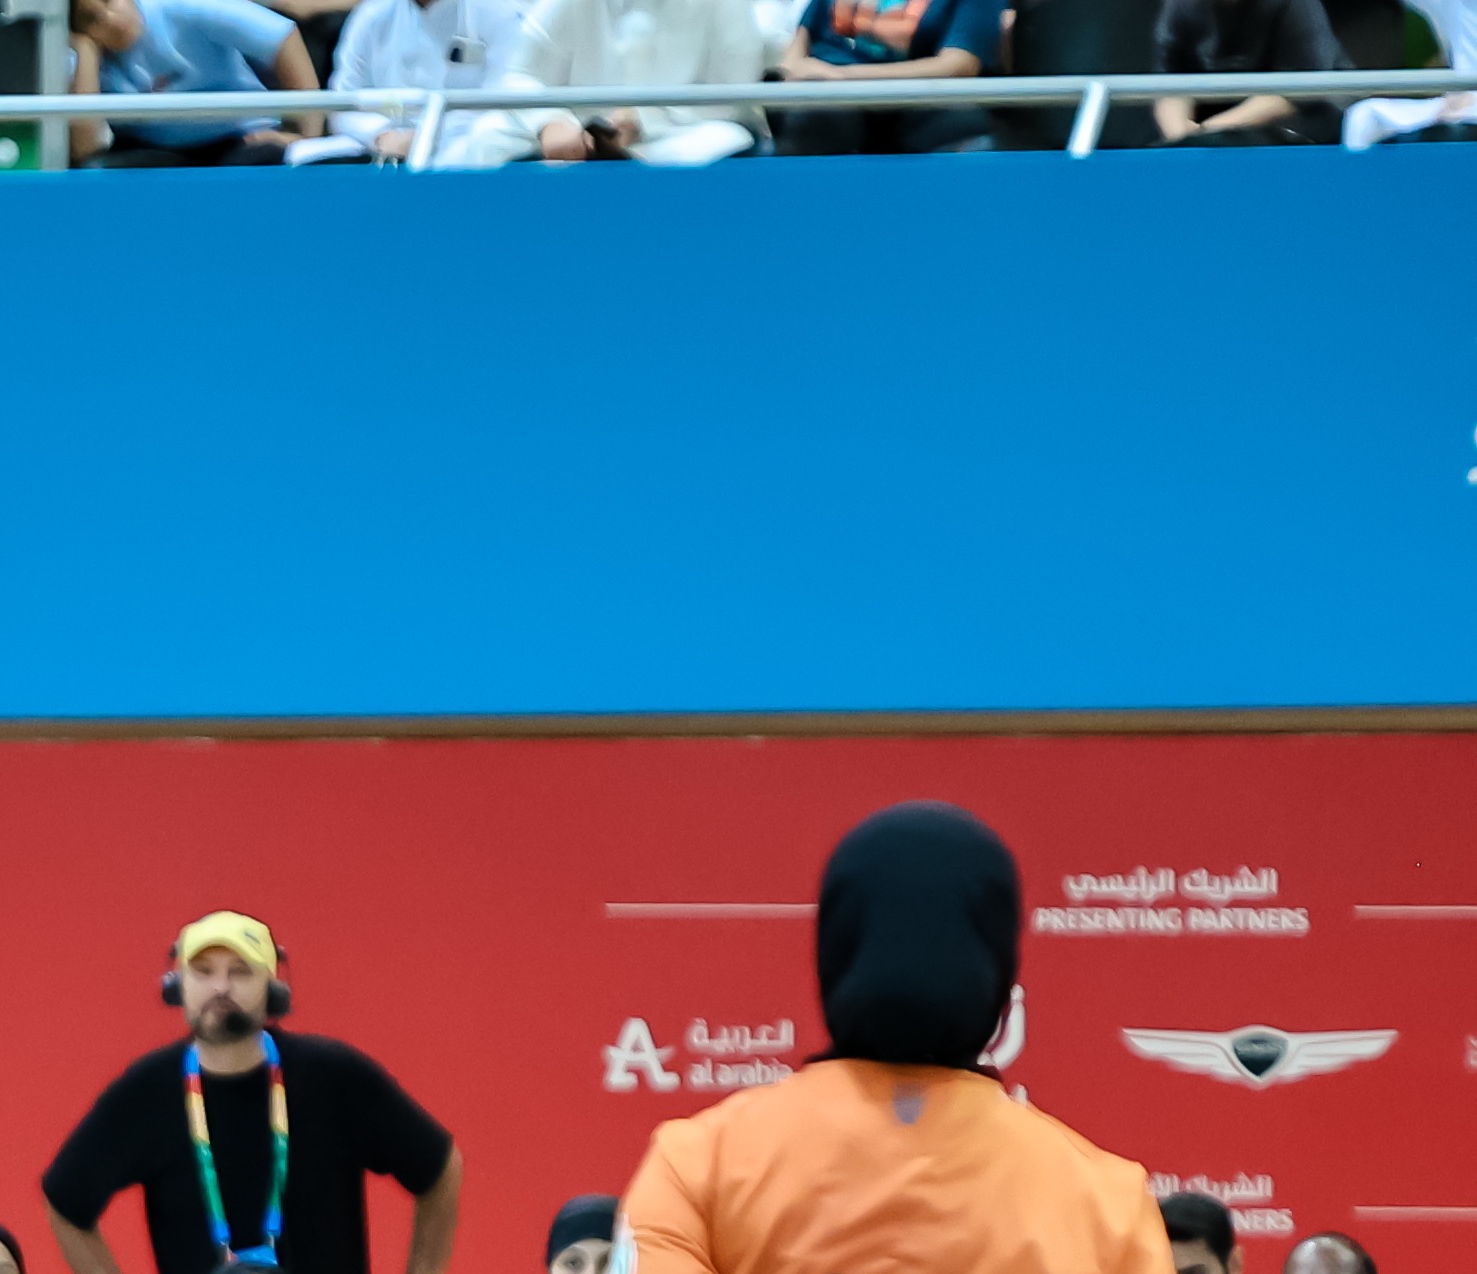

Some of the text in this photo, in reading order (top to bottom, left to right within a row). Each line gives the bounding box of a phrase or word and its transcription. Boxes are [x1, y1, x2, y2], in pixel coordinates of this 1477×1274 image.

[1064, 865, 1278, 907] الشريك الرئيسي
[1033, 906, 1310, 937] PRESENTING PARTNERS
[685, 1016, 795, 1054] العربية
